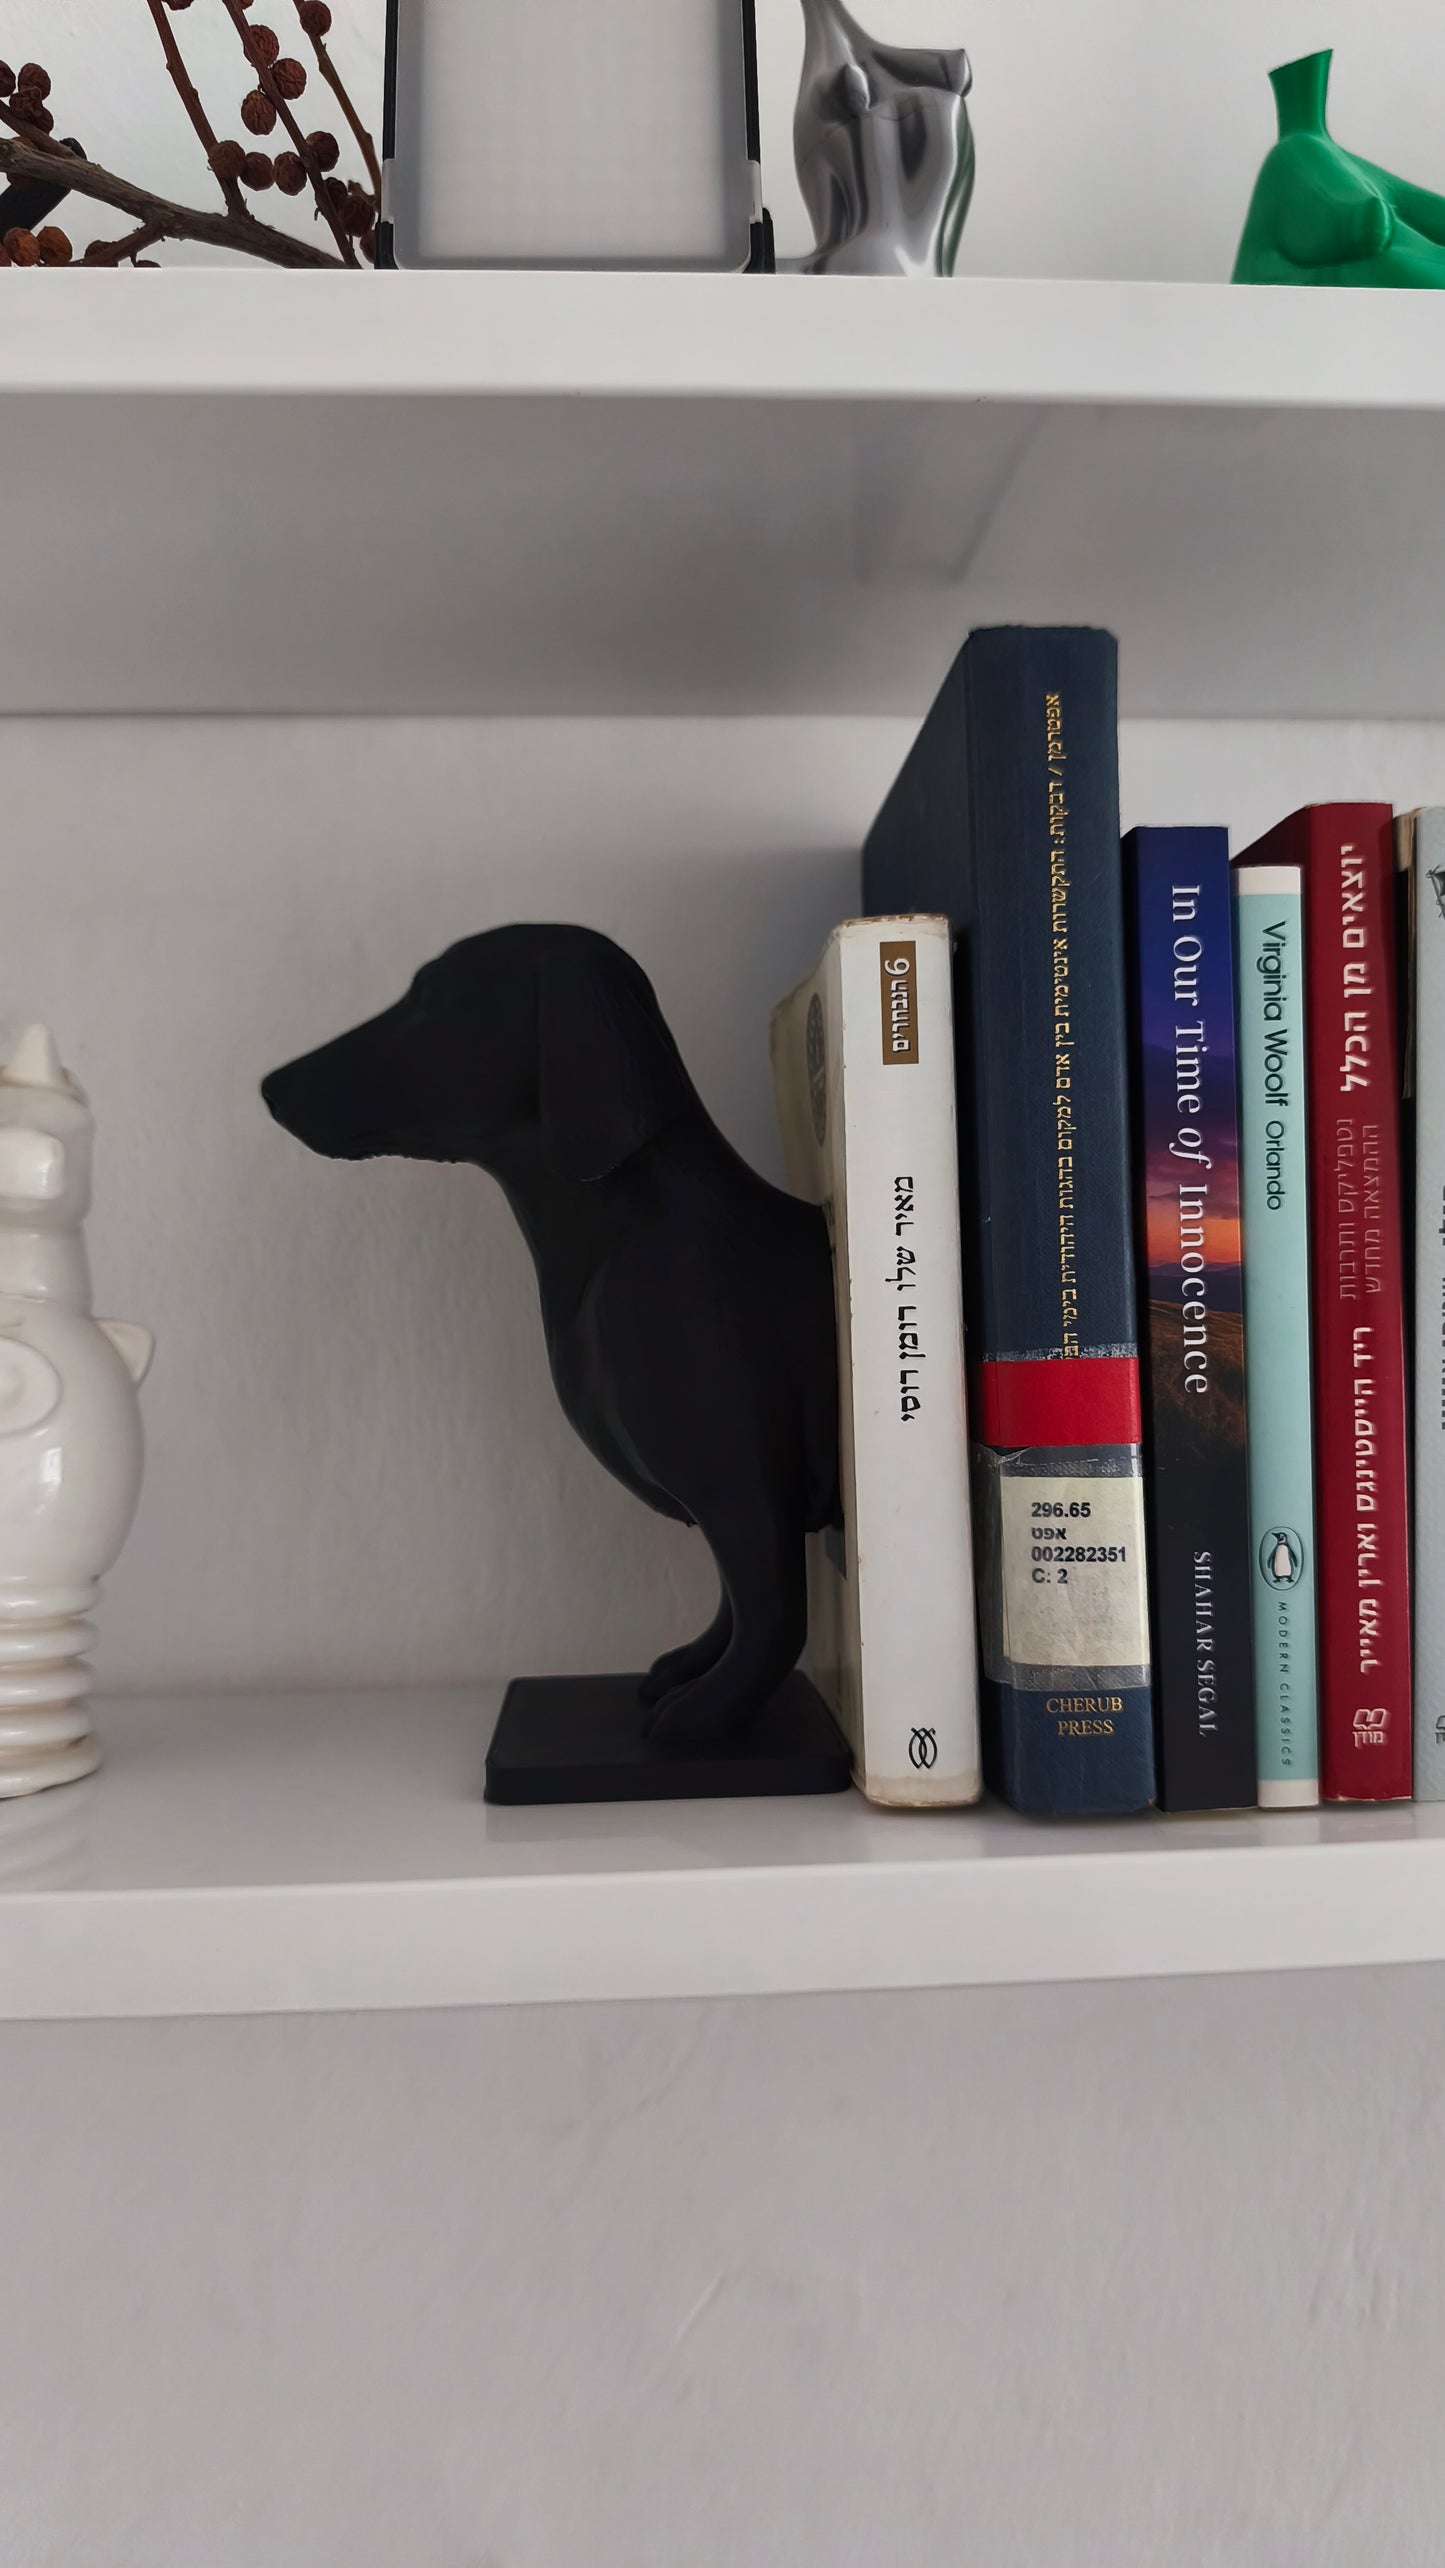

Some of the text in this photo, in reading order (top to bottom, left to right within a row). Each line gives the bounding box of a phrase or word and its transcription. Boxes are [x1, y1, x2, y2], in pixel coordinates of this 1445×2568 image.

[1046, 694, 1066, 761] אפטרמן
[1049, 782, 1068, 844] דבקות:
[1051, 851, 1070, 933] התקשרות
[1053, 938, 1069, 1017] אינטימית
[1339, 845, 1372, 1092] יוצאים מן הכלל
[884, 958, 910, 1052] 6 הנבחרים
[1055, 1022, 1074, 1048] בין
[1056, 1053, 1071, 1089] אדם
[1256, 921, 1288, 1210] Virginia Woolf Orlando
[1053, 1093, 1077, 1150] למקום
[1169, 884, 1212, 1393] In Our Time of Innocence
[1057, 1156, 1074, 1209] בהגות
[1333, 1119, 1358, 1300] נטפליקס ותרבות
[1362, 1125, 1381, 1293] ההמצאה מחדש
[1060, 1214, 1076, 1283] היהודית
[885, 1176, 926, 1422] מאיר שלו רומן רוסי
[1062, 1288, 1078, 1327] בימי
[1063, 1332, 1079, 1360] הב
[1031, 1502, 1091, 1517] 296.65
[1353, 1327, 1381, 1673] ריד הייסטינגס וארין מאייר
[1031, 1527, 1067, 1540] אפט
[1031, 1546, 1126, 1562] 002282351
[1032, 1568, 1068, 1584] C: 2
[1193, 1551, 1217, 1737] SHAHAR SEGAL
[1045, 1696, 1124, 1713] CHERUB
[1278, 1601, 1291, 1766] MODERN CLASSICS
[1057, 1719, 1114, 1736] PRESS
[1352, 1731, 1384, 1748] מודן
